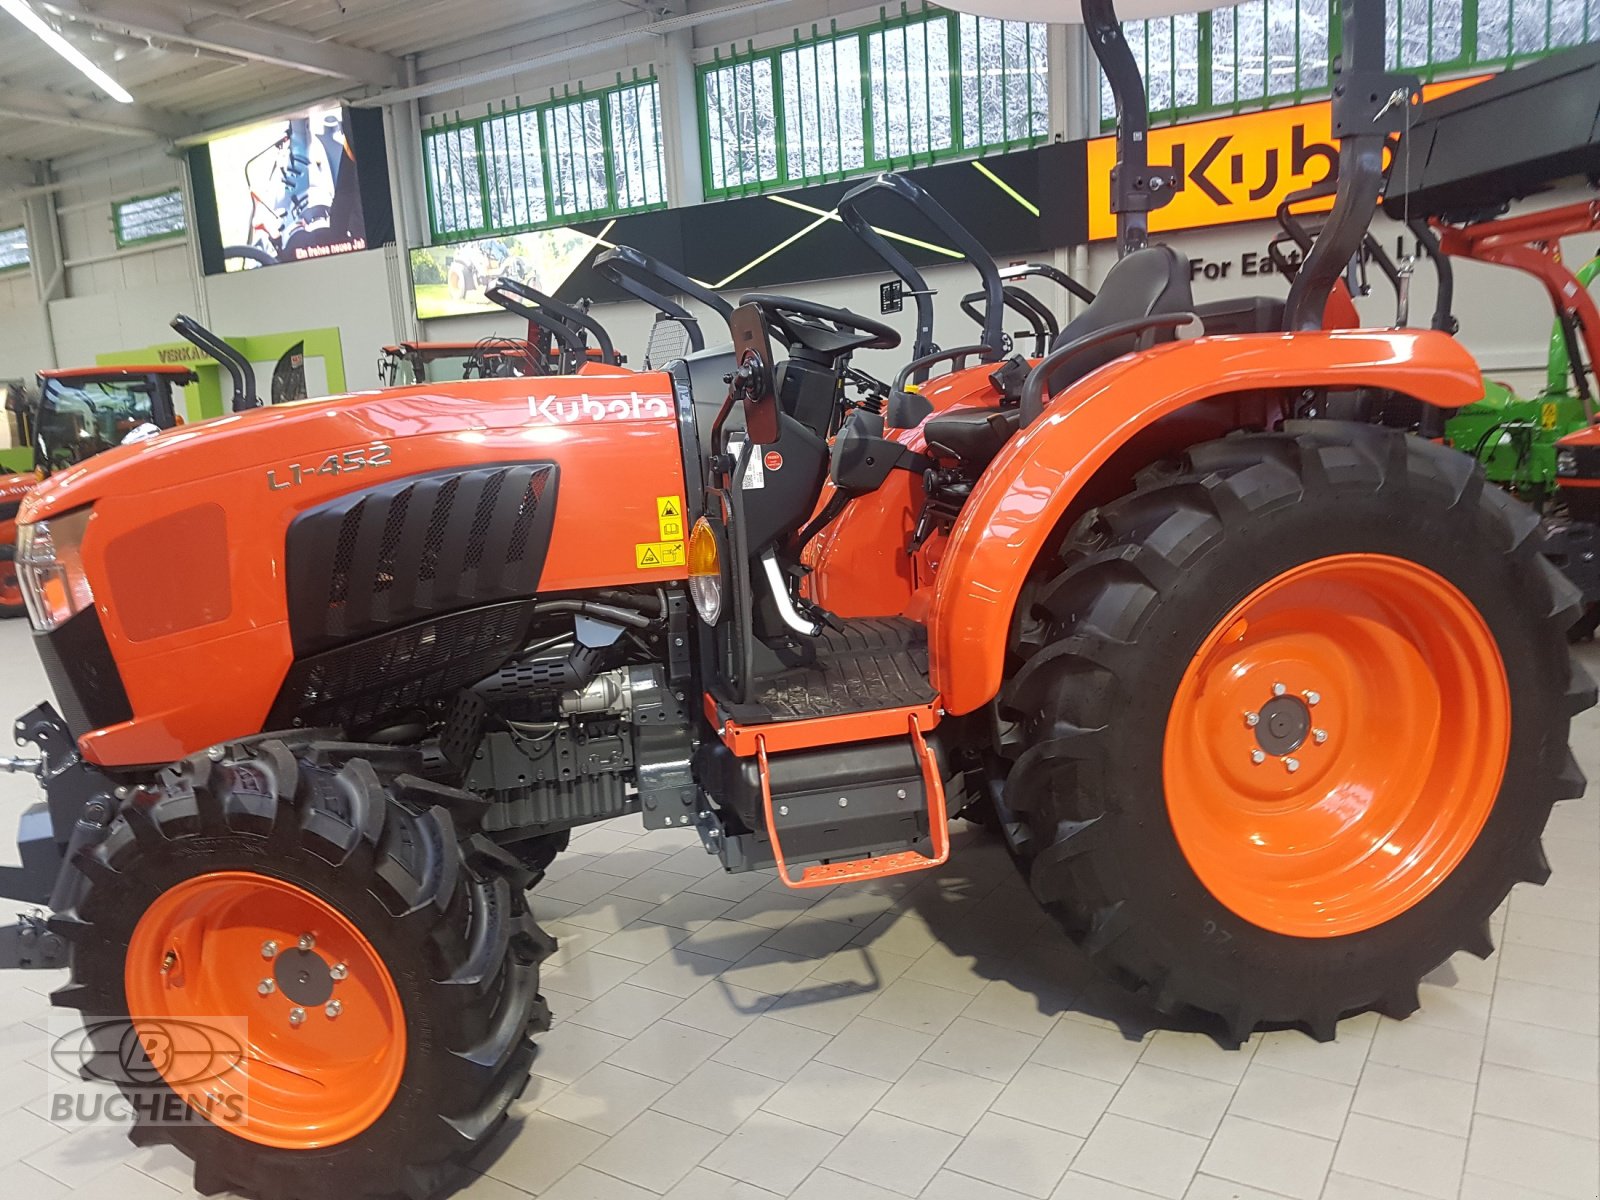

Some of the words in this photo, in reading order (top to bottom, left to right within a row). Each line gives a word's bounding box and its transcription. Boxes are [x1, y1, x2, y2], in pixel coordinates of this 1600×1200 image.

[331, 242, 352, 253] neues
[1190, 258, 1232, 280] For
[527, 391, 669, 424] Kubota
